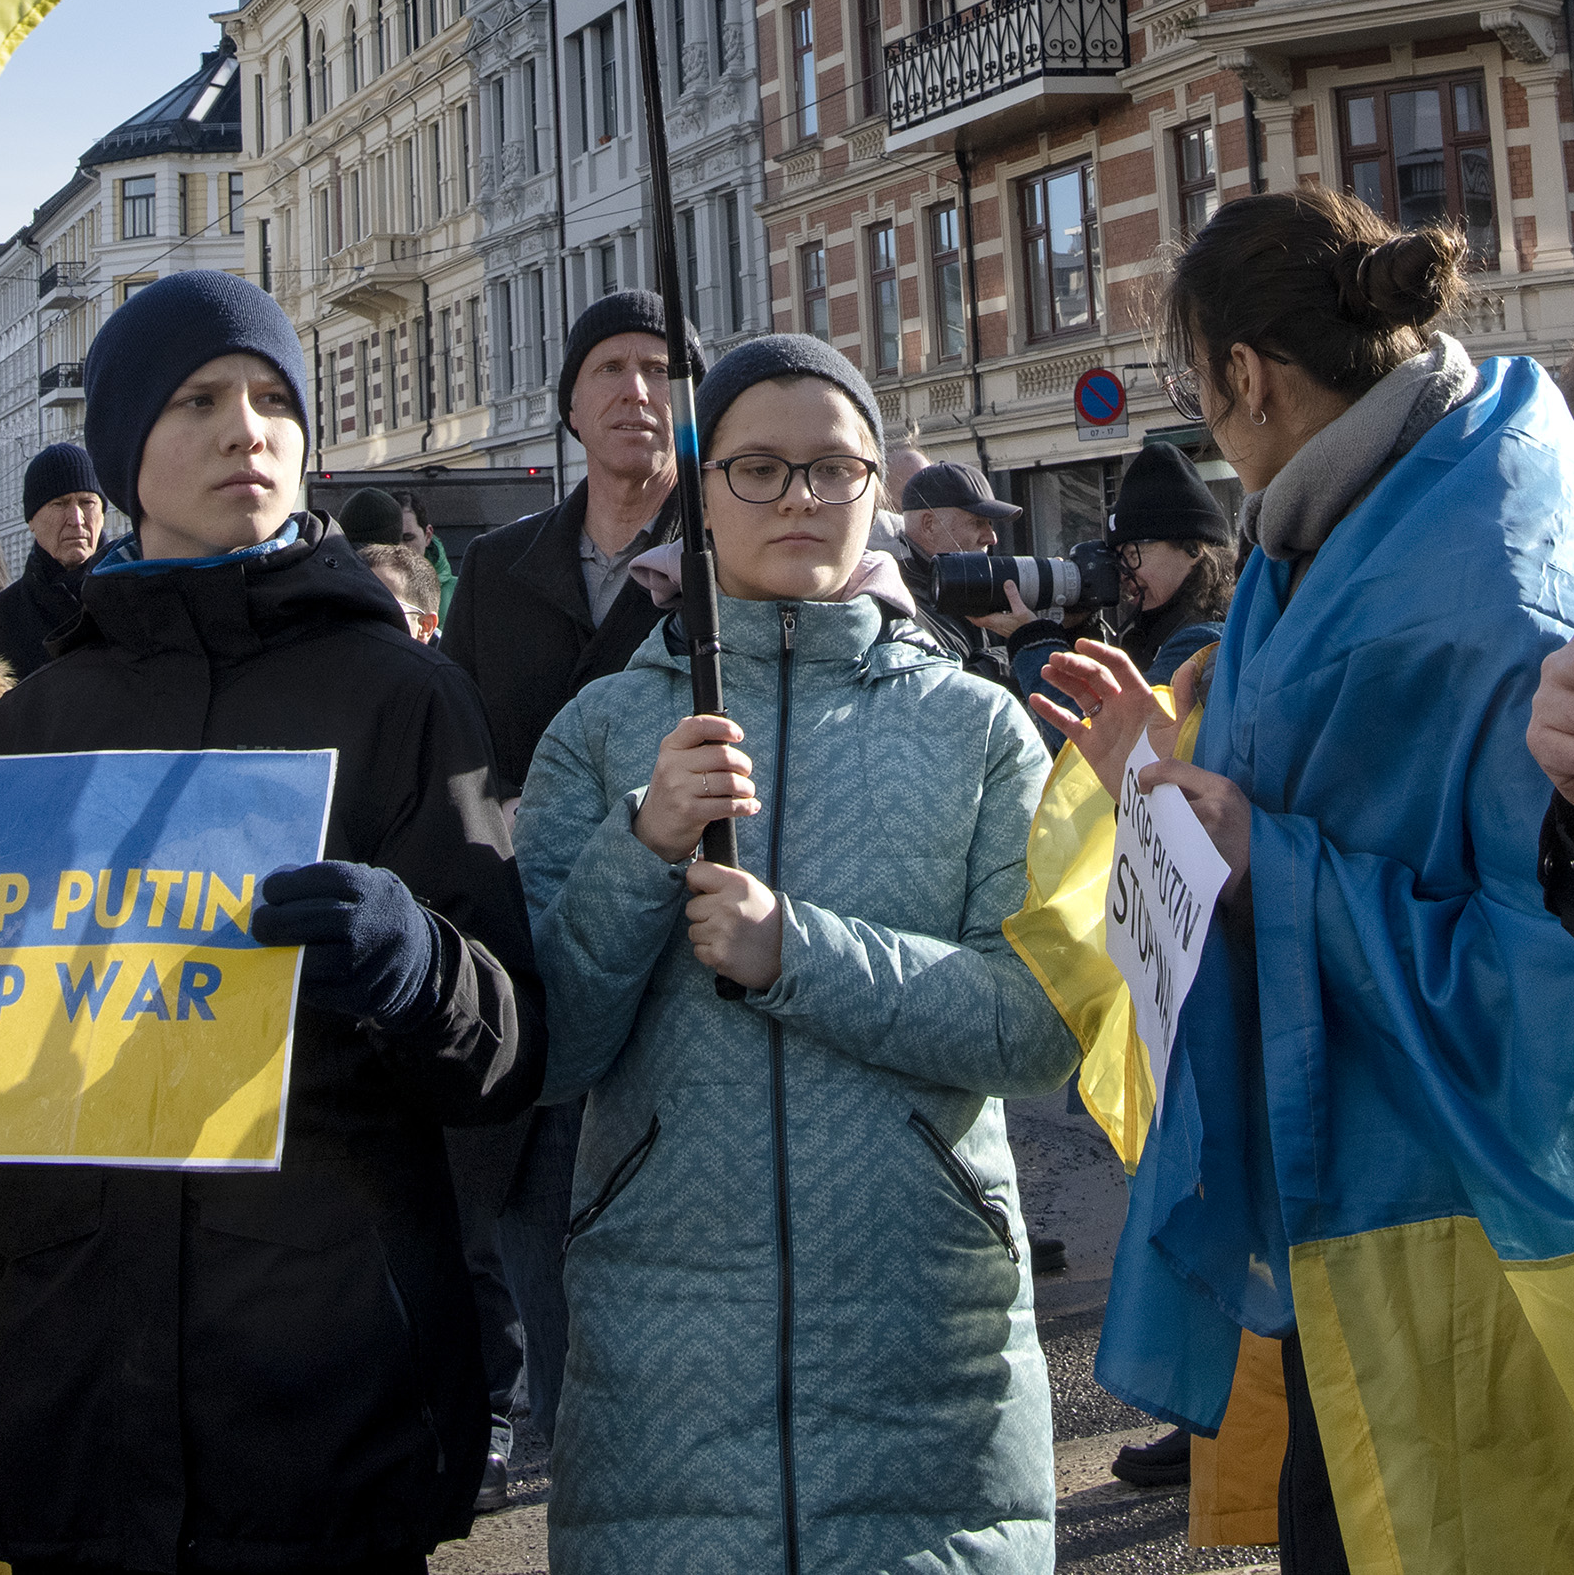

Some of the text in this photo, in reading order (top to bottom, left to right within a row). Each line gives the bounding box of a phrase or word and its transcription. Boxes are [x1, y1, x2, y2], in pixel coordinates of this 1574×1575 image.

[1123, 767, 1202, 952] STOP PUTIN
[52, 868, 256, 935] PUTIN
[56, 959, 223, 1023] WAR
